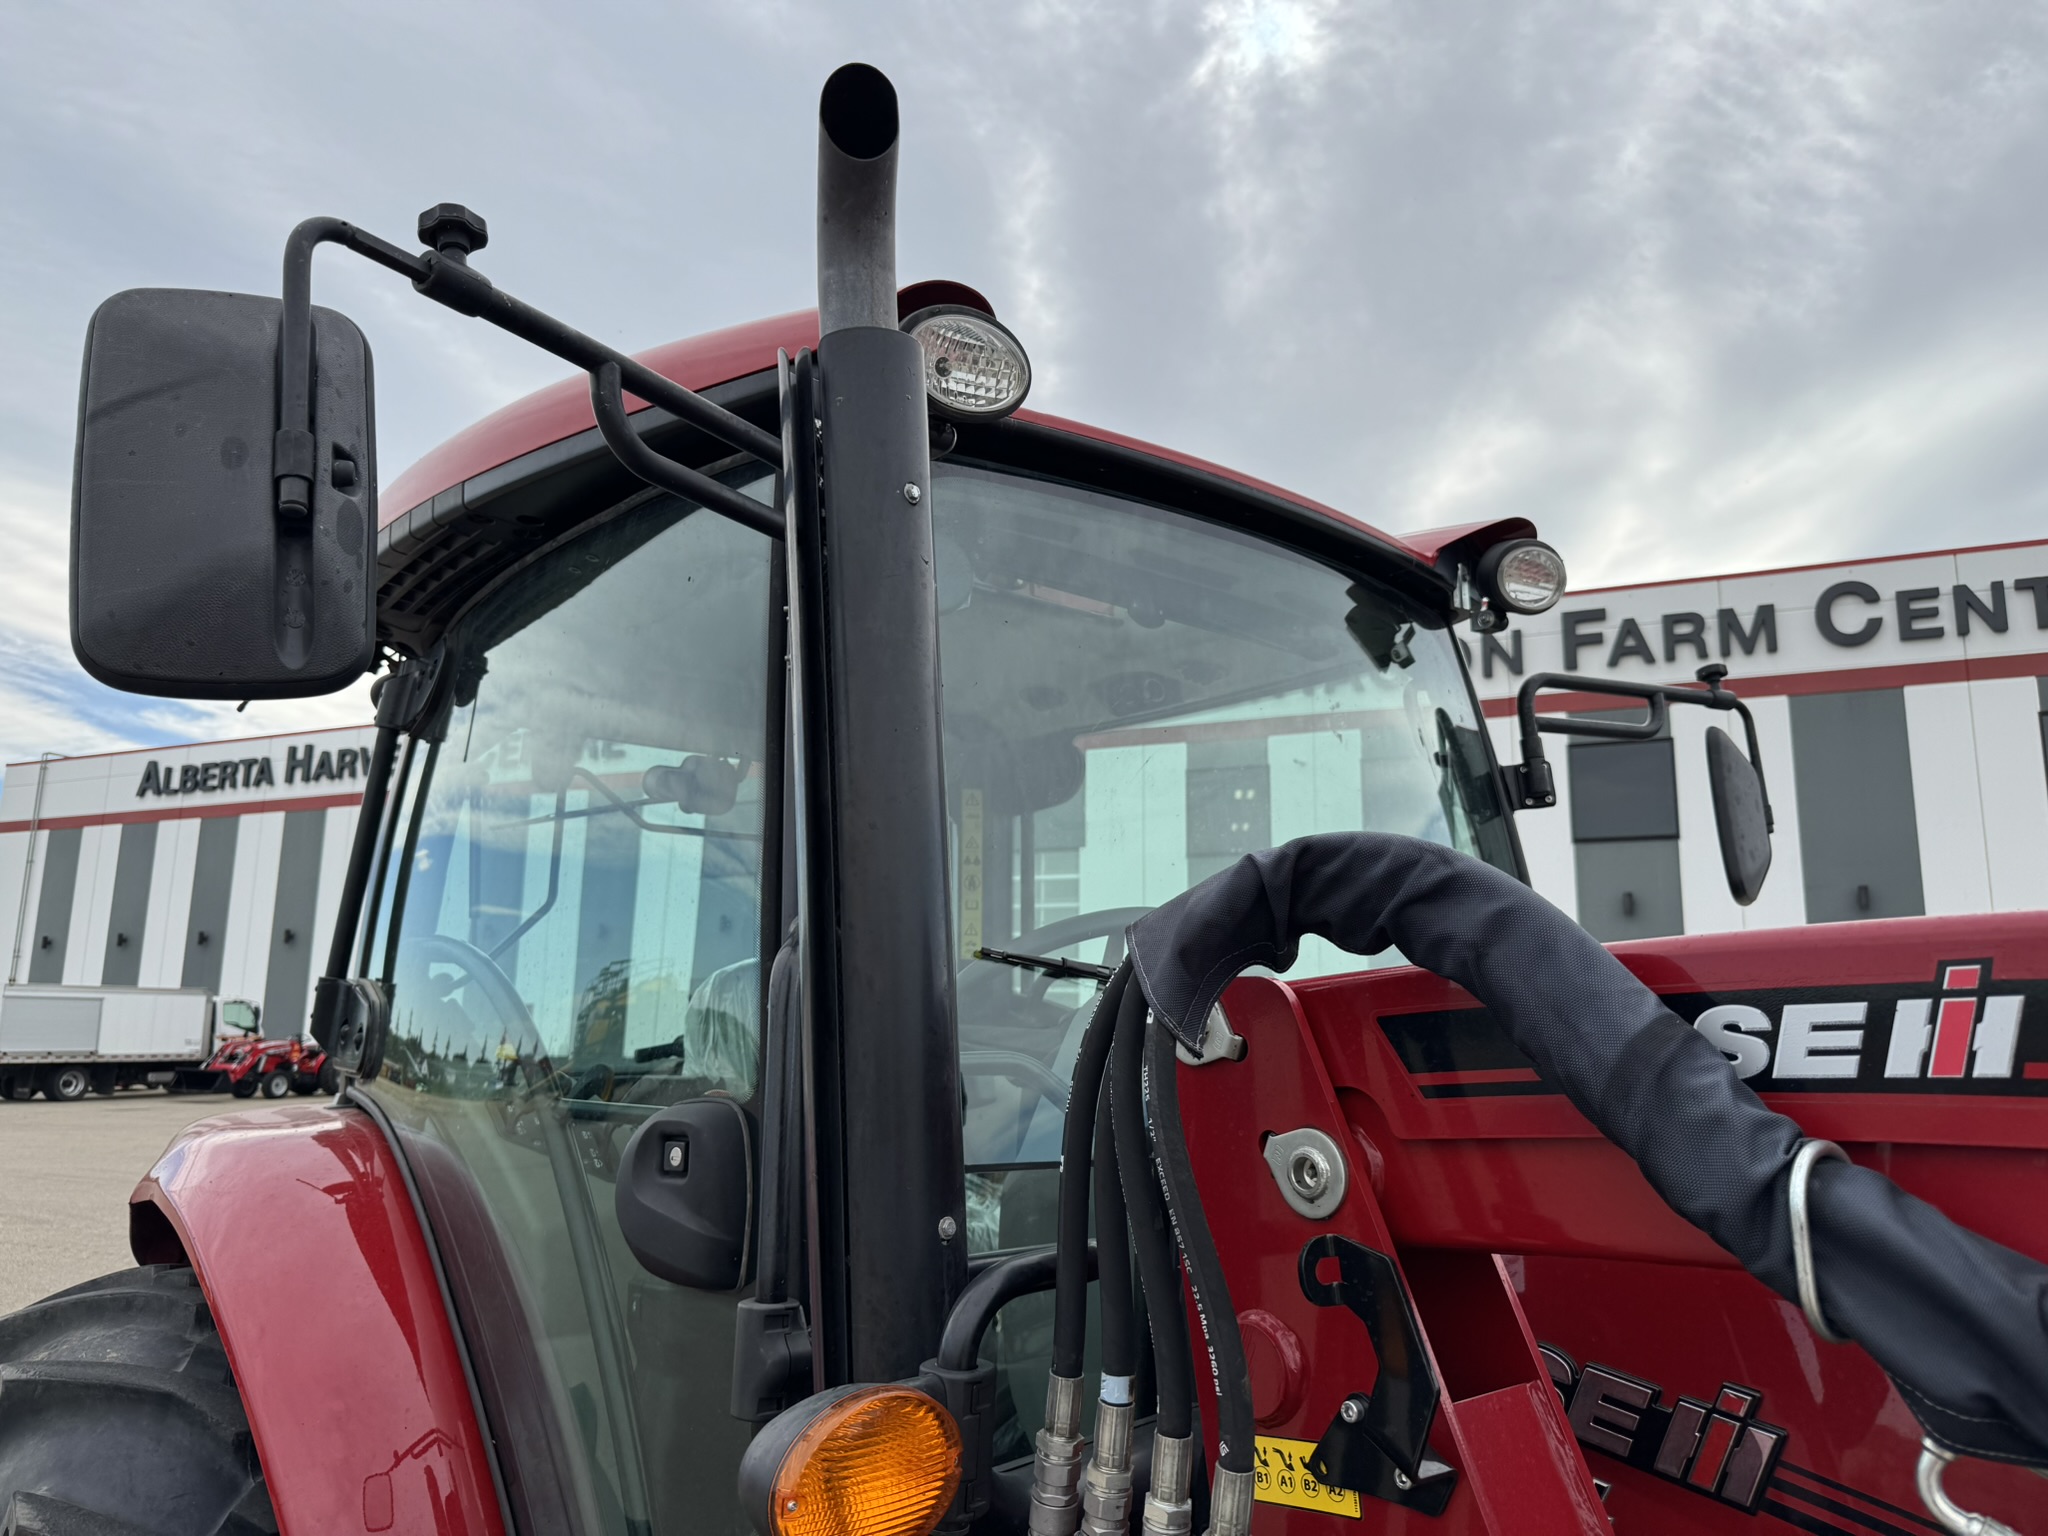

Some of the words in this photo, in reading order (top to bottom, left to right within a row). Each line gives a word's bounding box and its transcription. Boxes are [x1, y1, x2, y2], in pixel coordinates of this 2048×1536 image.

[1561, 604, 1778, 670] FARM
[136, 757, 274, 798] ALBERTA
[1155, 1157, 1170, 1201] EXCEED
[1168, 1208, 1178, 1226] EN
[1182, 1252, 1193, 1274] 1SC
[1190, 1285, 1203, 1312] 22.5
[1207, 1345, 1219, 1376] 3260
[1256, 1471, 1269, 1485] B1
[1280, 1475, 1293, 1488] A1
[1303, 1478, 1318, 1492] B2
